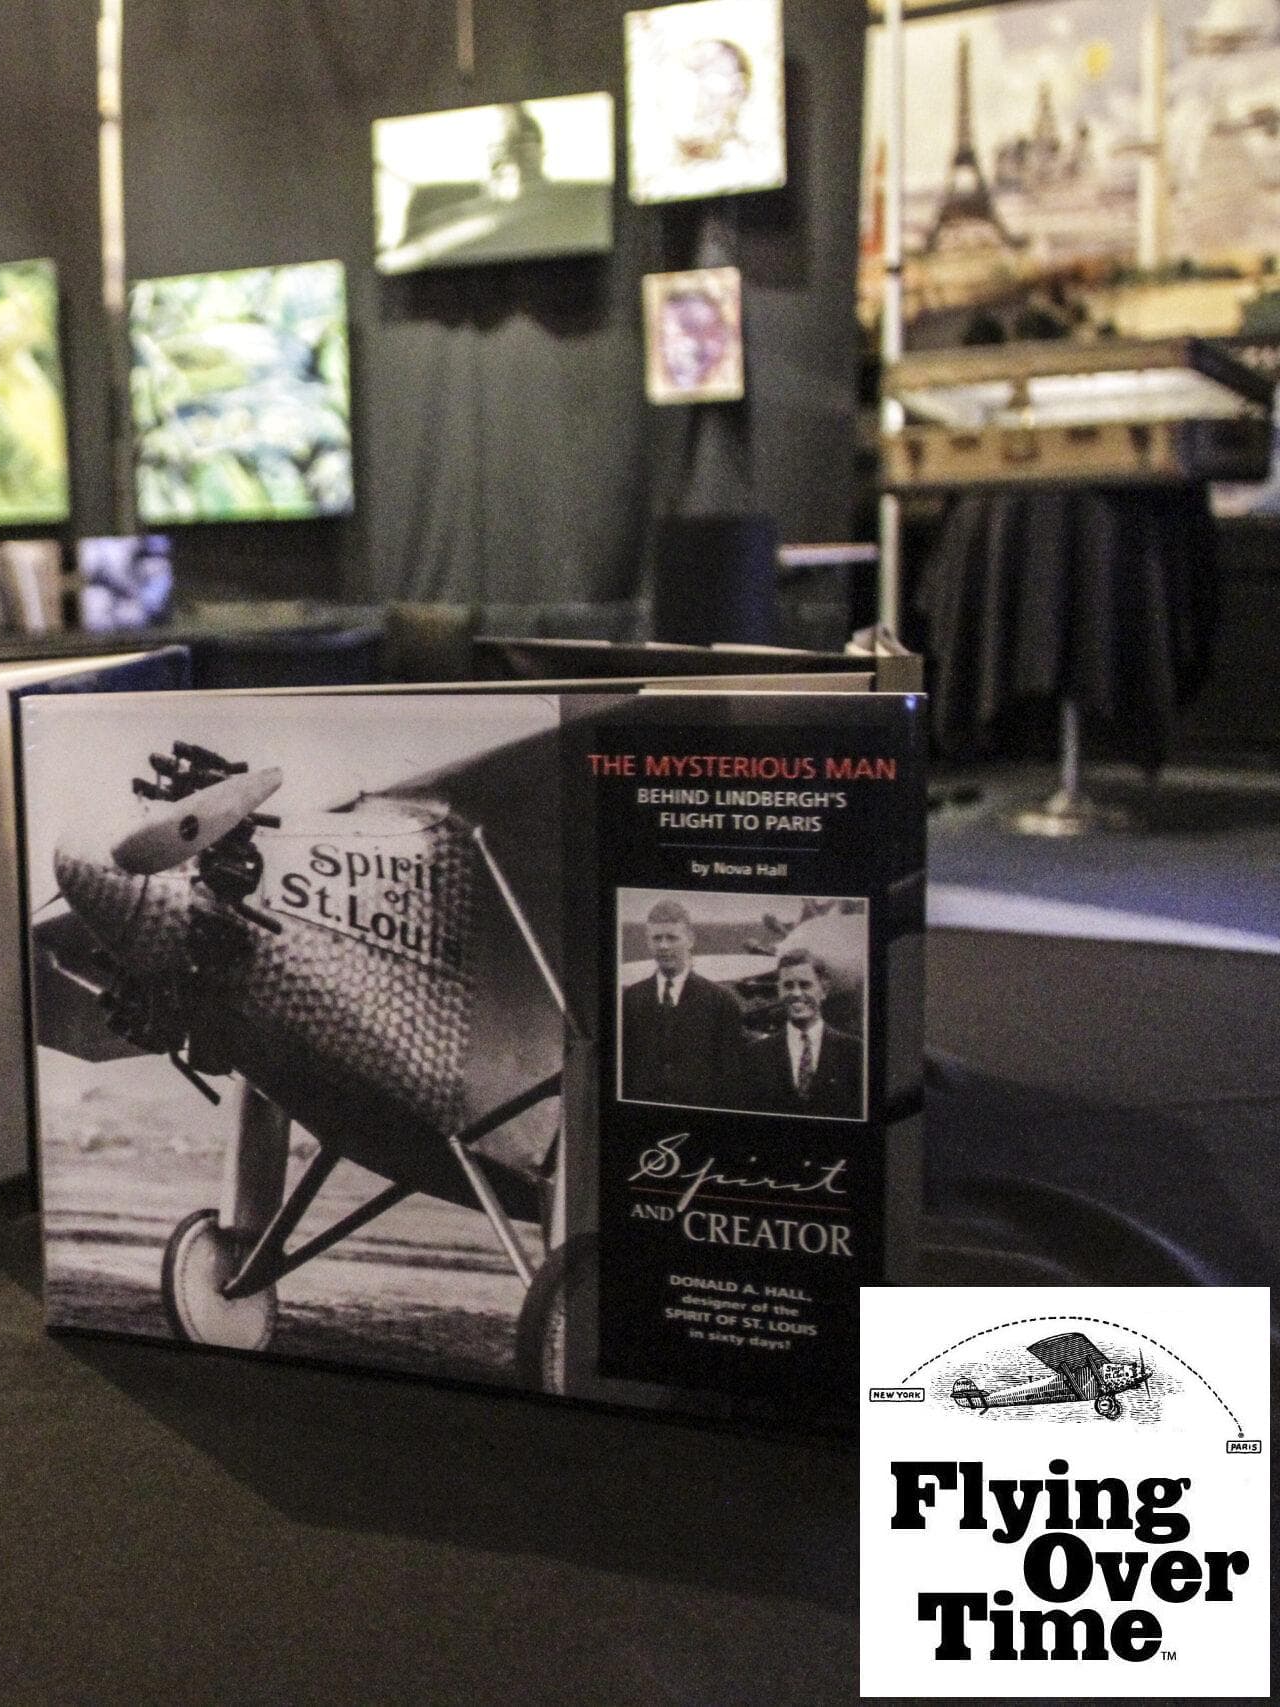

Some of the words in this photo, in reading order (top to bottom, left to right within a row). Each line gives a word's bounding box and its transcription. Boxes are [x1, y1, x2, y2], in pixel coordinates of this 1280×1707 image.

[587, 754, 637, 776] THE
[645, 755, 817, 780] MYSTERIOUS
[825, 757, 897, 781] MAN
[637, 788, 709, 805] BEHIND
[715, 790, 848, 808] LINDBERGH'S
[660, 812, 725, 830] FLIGHT
[731, 814, 759, 831] TO
[766, 815, 822, 832] PARIS
[691, 860, 710, 877] by
[713, 862, 752, 876] Nova
[756, 863, 788, 877] Hall
[280, 872, 342, 923] St.
[384, 888, 418, 915] of
[628, 1132, 848, 1213] Spirit
[630, 1203, 675, 1222] AND
[683, 1210, 853, 1257] CREATOR
[670, 1274, 738, 1293] DONALD
[742, 1283, 760, 1295] A.
[681, 1293, 747, 1311] designer
[751, 1302, 769, 1313] of
[773, 1304, 800, 1317] the
[665, 1307, 712, 1323] SPIRIT
[715, 1314, 737, 1326] OF
[769, 1320, 818, 1337] LOUIS
[689, 1328, 705, 1339] in
[707, 1331, 746, 1347] sixty
